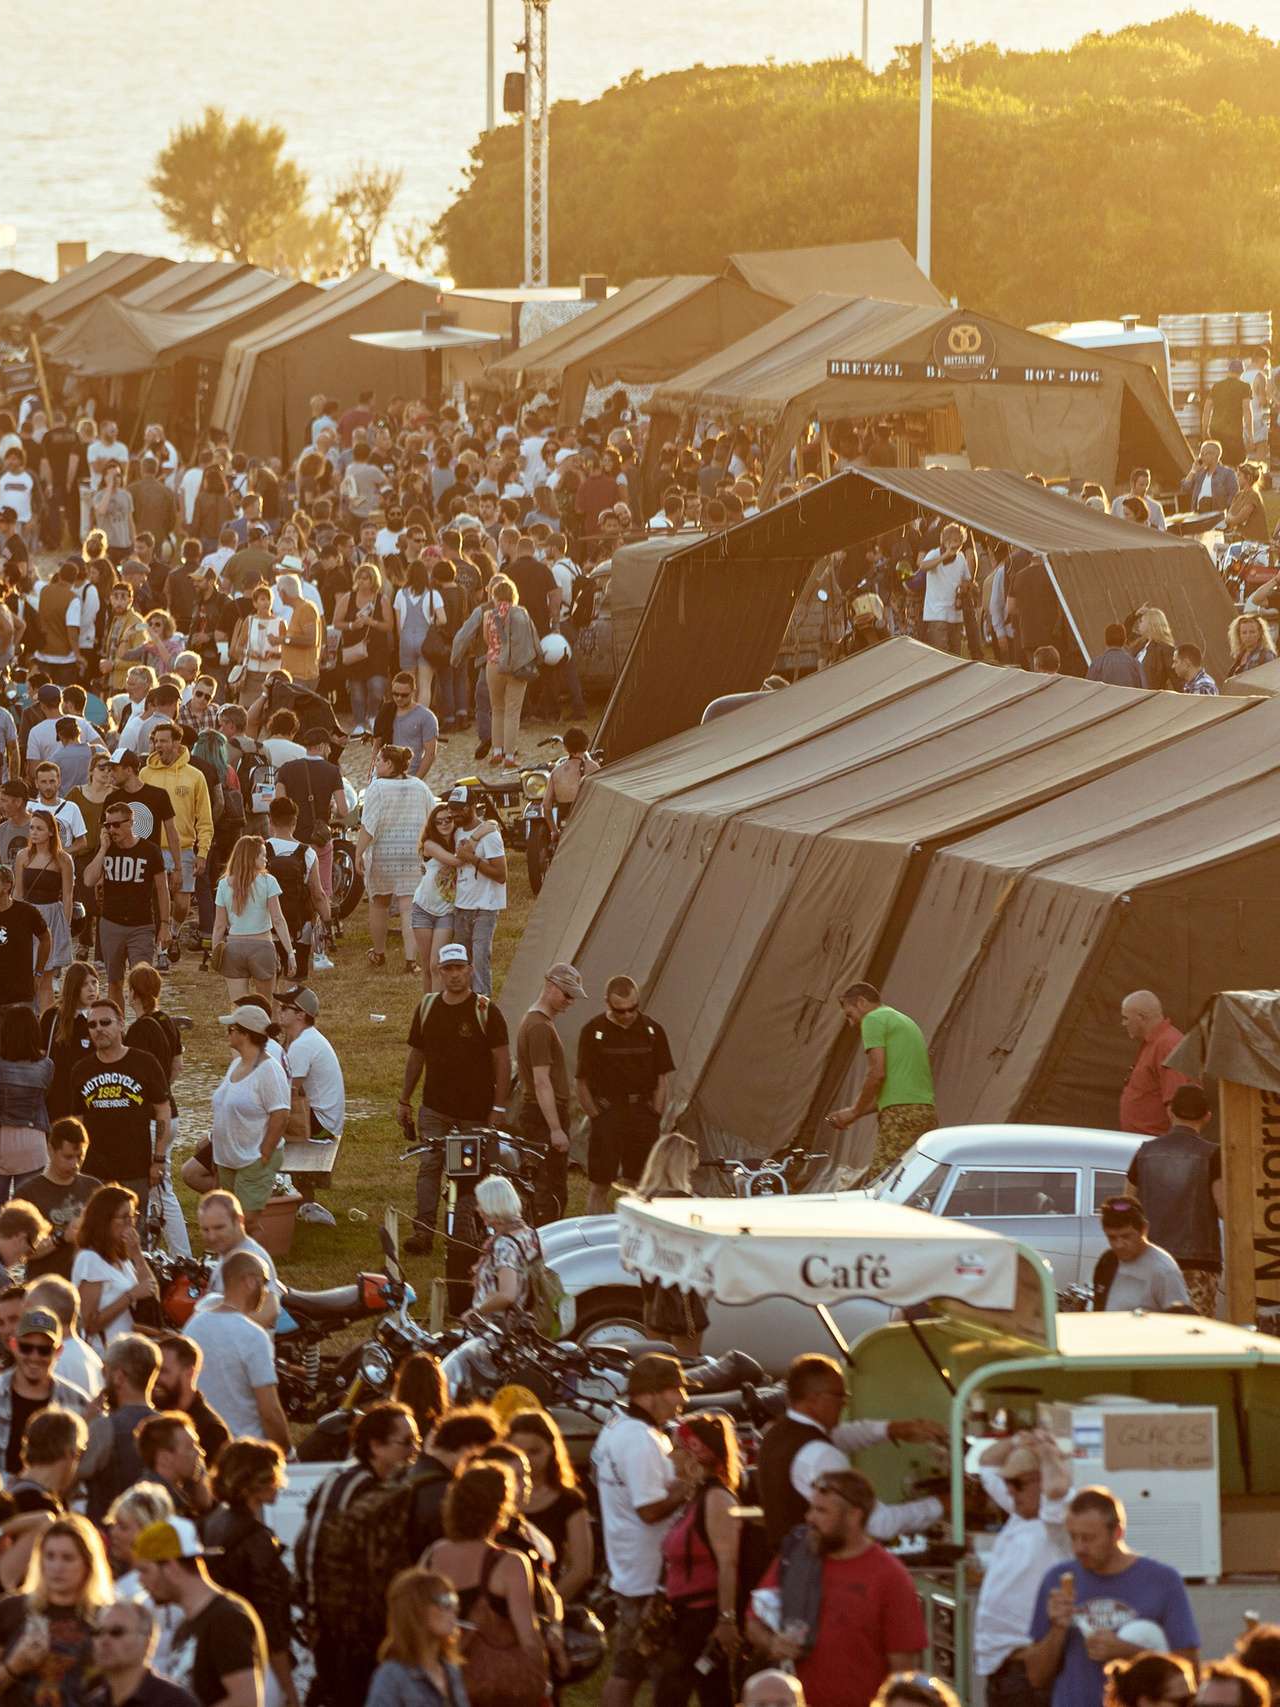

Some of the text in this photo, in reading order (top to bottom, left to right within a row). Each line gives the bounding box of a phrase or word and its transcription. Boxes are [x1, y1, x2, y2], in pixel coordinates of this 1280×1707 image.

[830, 361, 903, 377] BRETZEL
[103, 856, 147, 883] RIDE
[81, 1072, 142, 1097] MOTORCYCLE
[97, 1086, 122, 1099] 1982
[800, 1253, 891, 1289] Café
